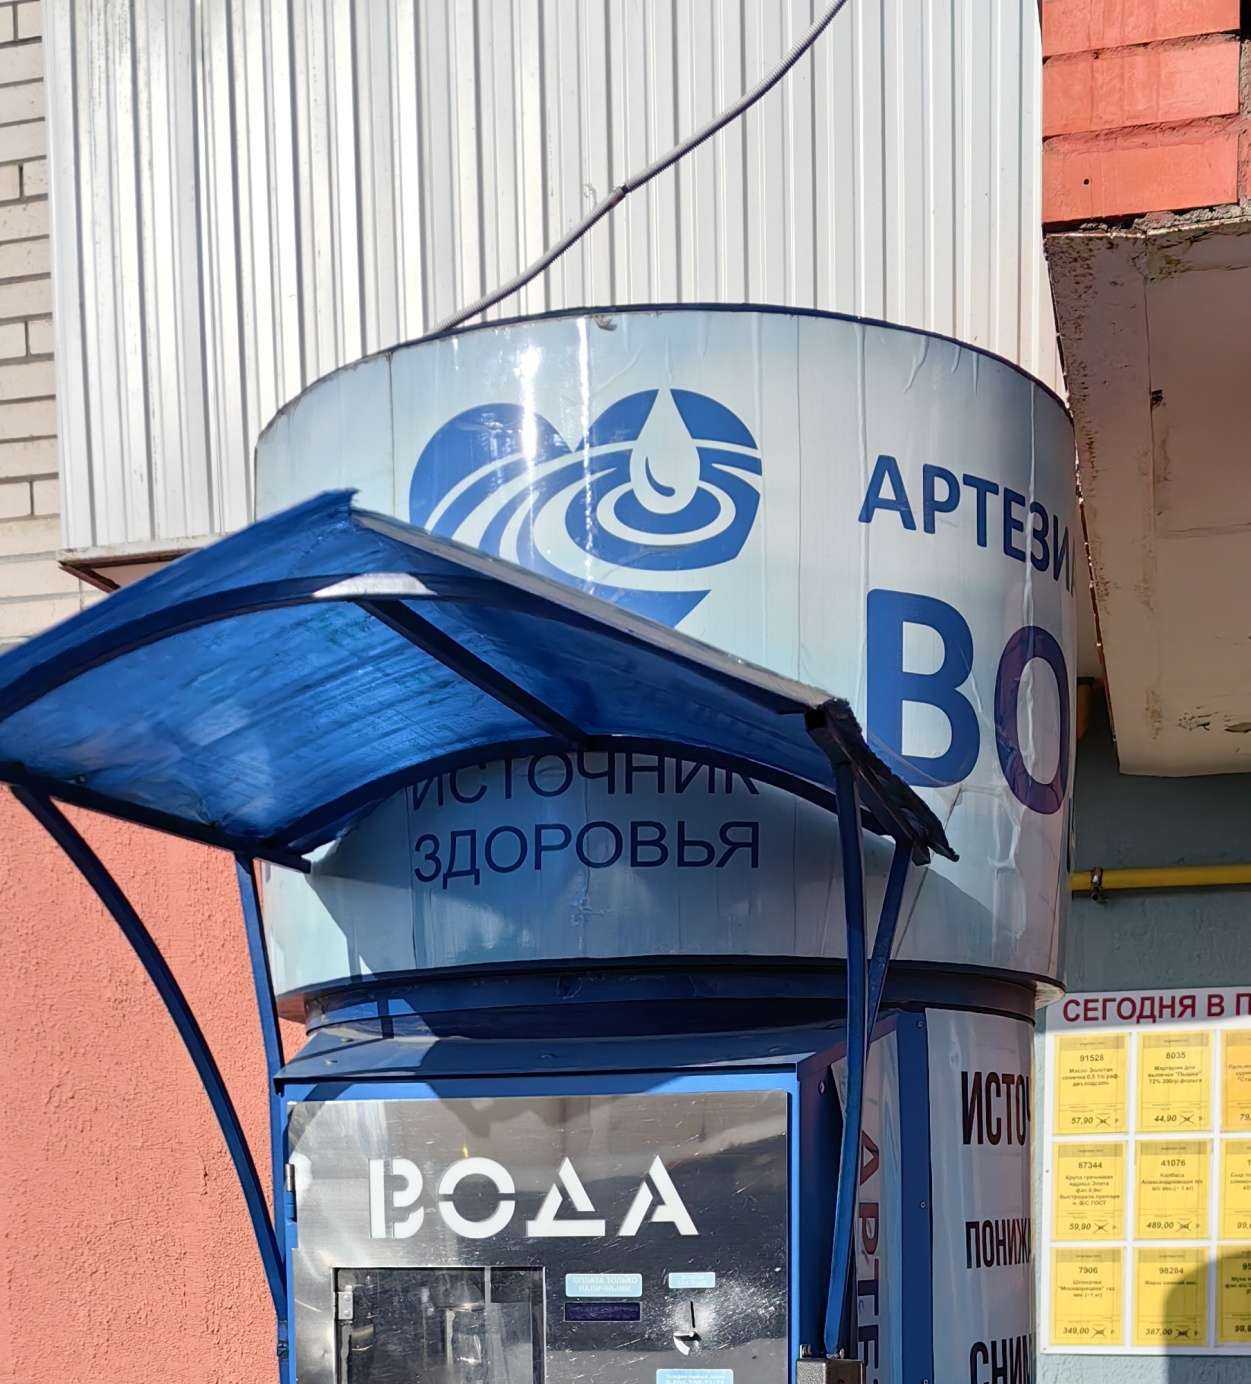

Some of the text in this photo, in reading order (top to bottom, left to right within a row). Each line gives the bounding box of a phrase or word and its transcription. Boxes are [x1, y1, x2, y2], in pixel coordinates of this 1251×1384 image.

[866, 588, 1069, 815] ВО
[413, 820, 760, 890] ЗДОРОВЬЯ
[1063, 994, 1196, 1024] СЕГОДНЯ
[1207, 994, 1225, 1018] В
[368, 1154, 700, 1240] ВОДА
